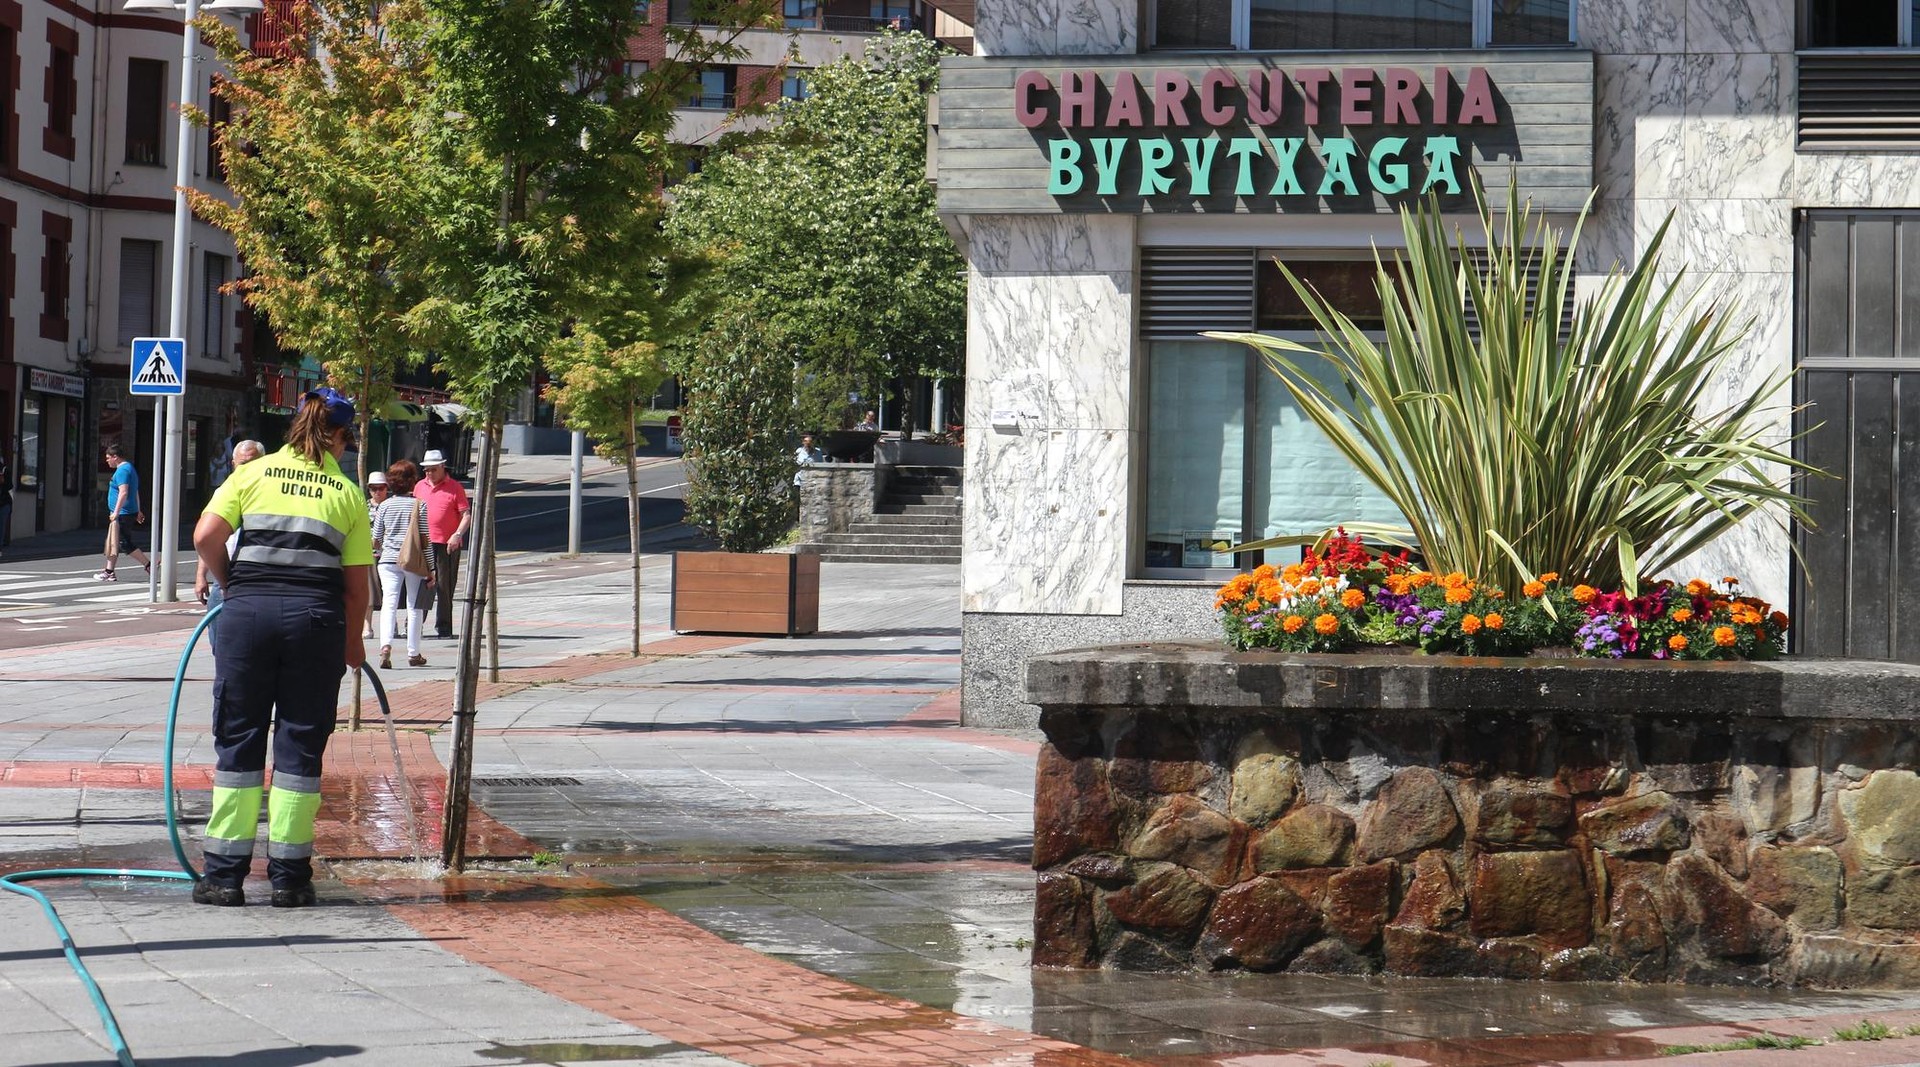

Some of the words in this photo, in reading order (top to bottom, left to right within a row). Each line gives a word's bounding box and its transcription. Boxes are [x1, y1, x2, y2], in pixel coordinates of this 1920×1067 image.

[1015, 66, 1498, 128] CHARCUTERIA
[264, 467, 344, 491] AMURRIOKO
[281, 482, 323, 499] UDALA
